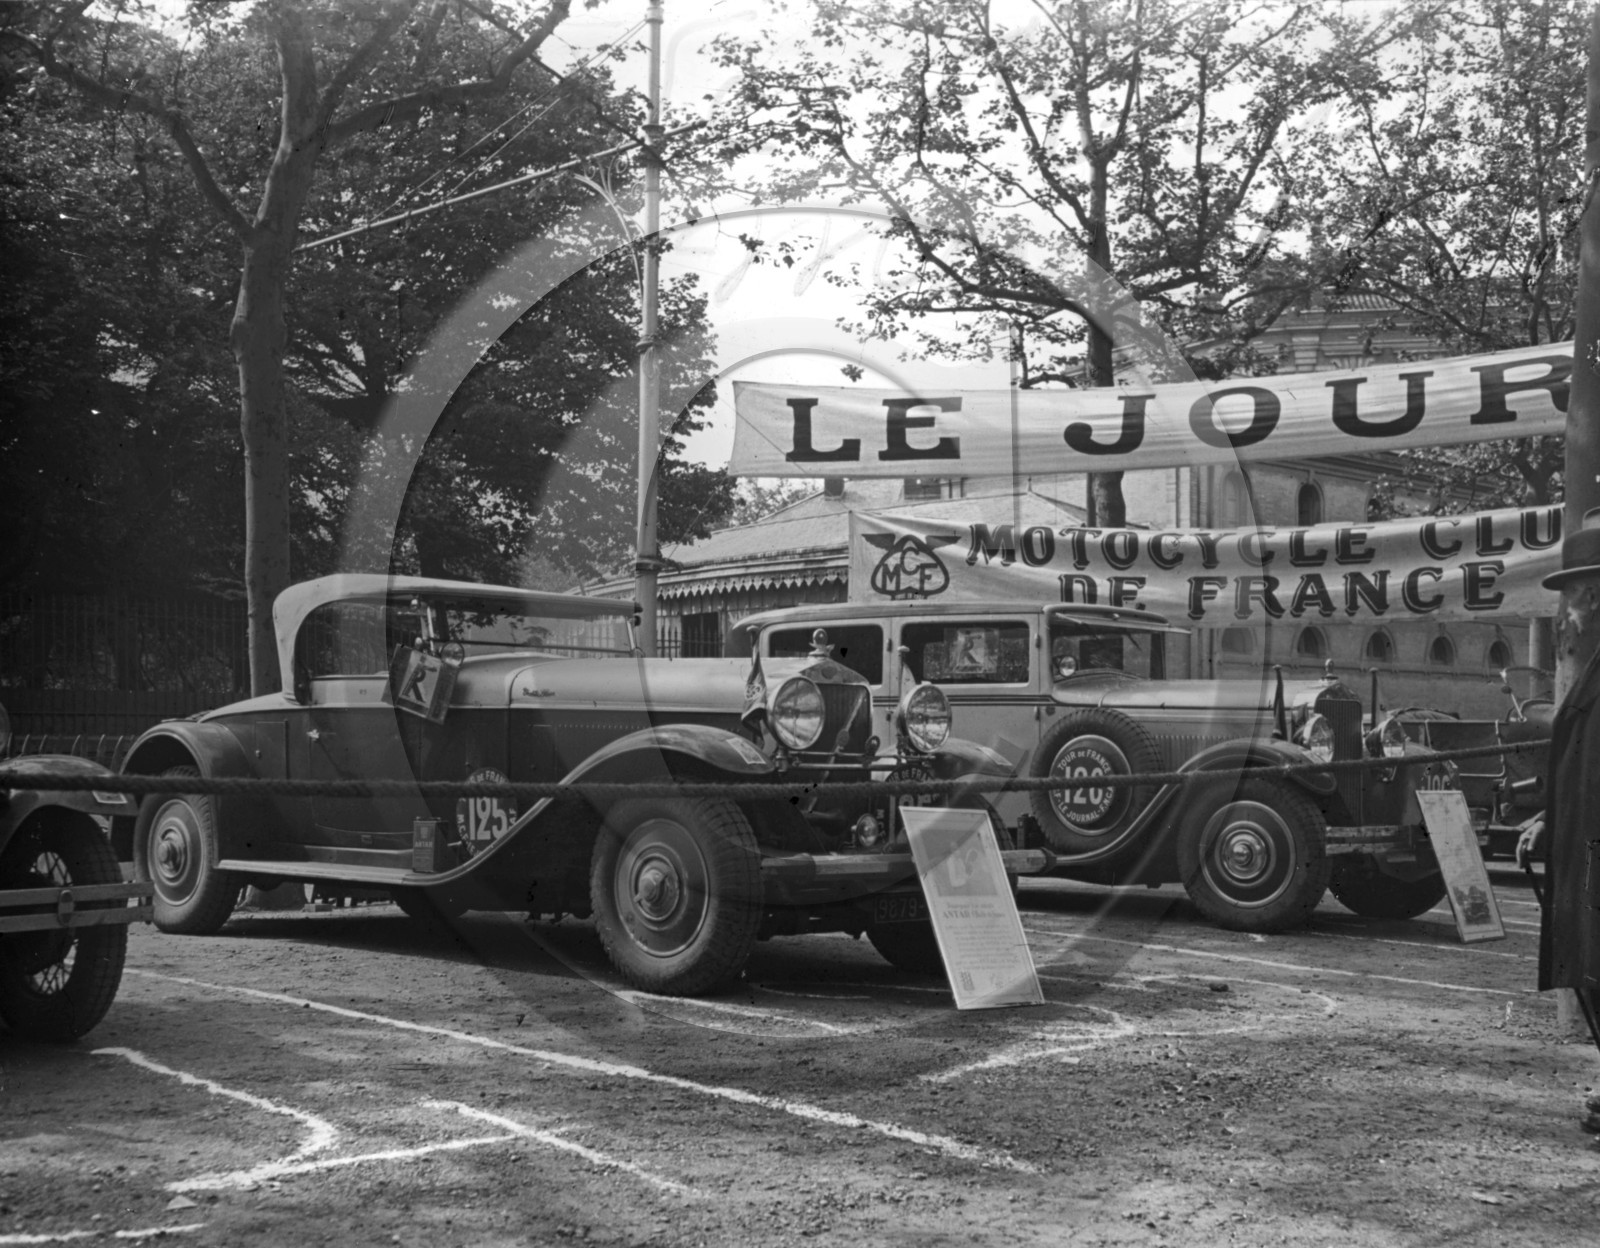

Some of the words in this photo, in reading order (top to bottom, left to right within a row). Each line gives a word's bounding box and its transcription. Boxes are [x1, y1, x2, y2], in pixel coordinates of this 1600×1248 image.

[786, 397, 962, 462] LE
[966, 524, 1376, 570] MOTOCYCLE
[1058, 574, 1146, 610] DE
[1187, 560, 1505, 620] FRANCE
[1057, 750, 1077, 770] TOUR
[1078, 750, 1086, 758] DE
[1086, 749, 1112, 774] FRANCE
[1064, 766, 1104, 805] 120
[468, 797, 508, 841] 125
